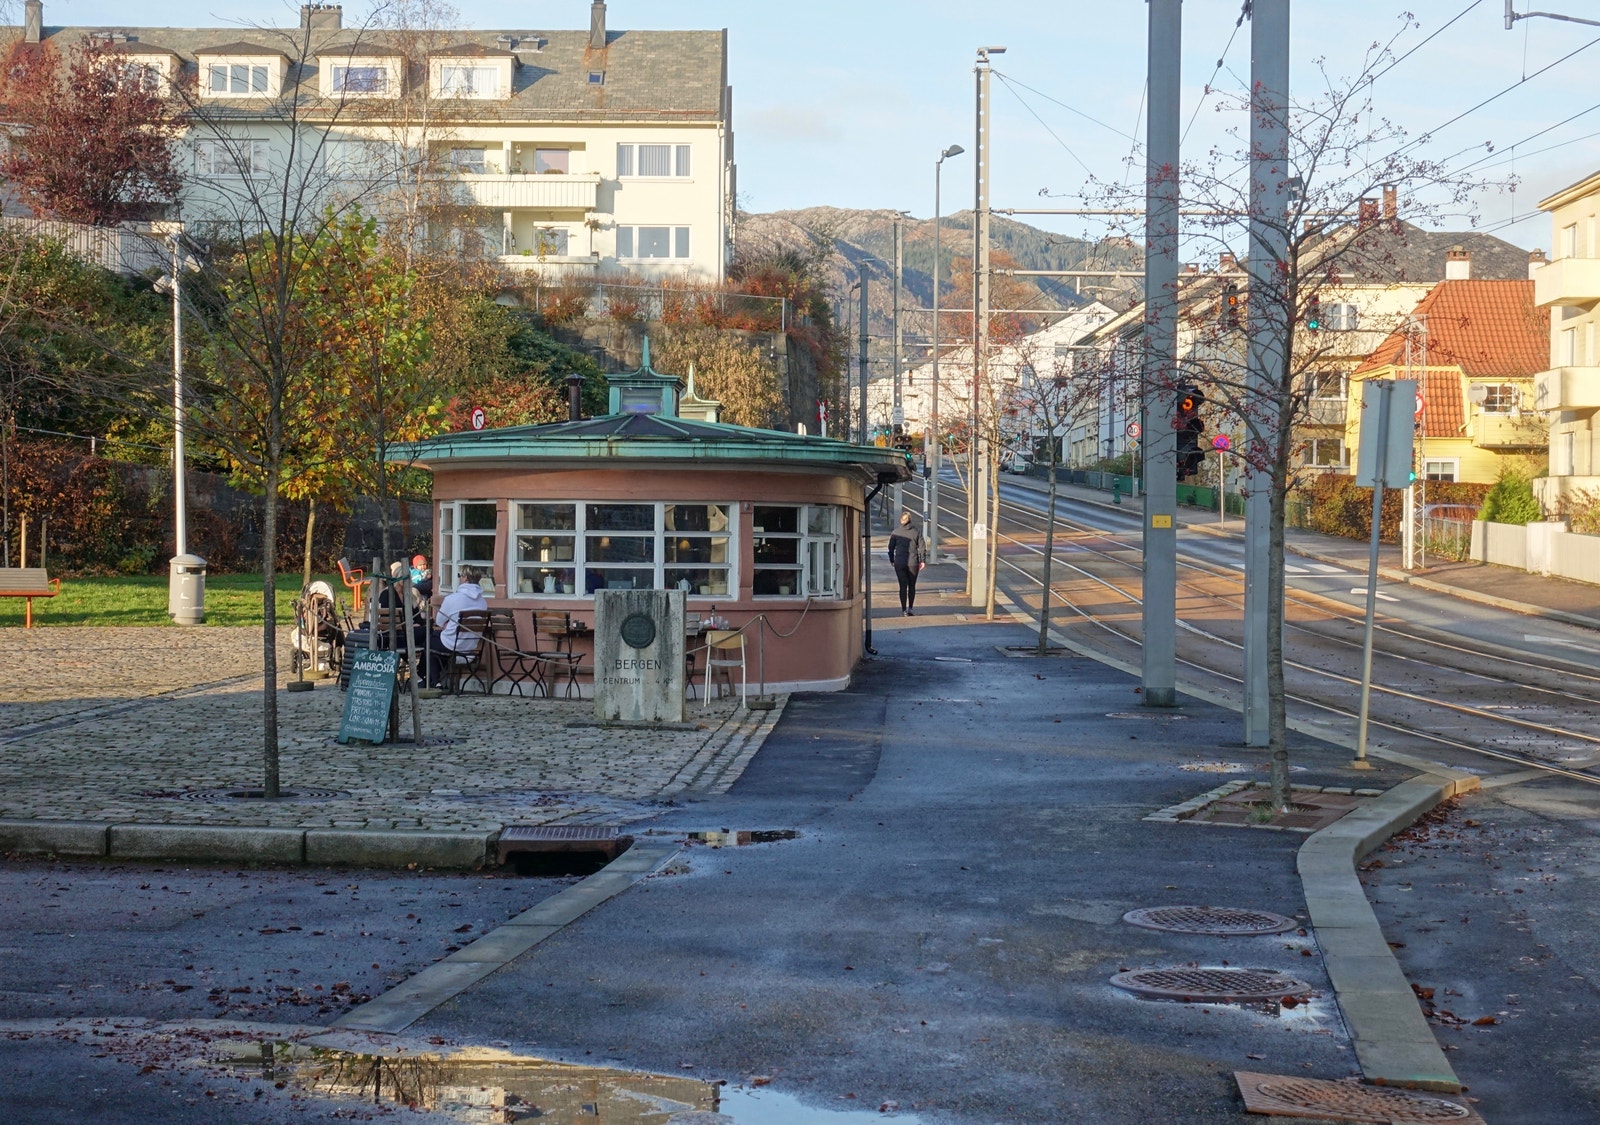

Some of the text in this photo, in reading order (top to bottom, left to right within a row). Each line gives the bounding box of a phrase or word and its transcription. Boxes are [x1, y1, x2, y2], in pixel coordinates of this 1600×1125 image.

[353, 661, 395, 673] AMBROSIA
[615, 659, 662, 670] BERGEN
[603, 677, 641, 685] CENTRUM
